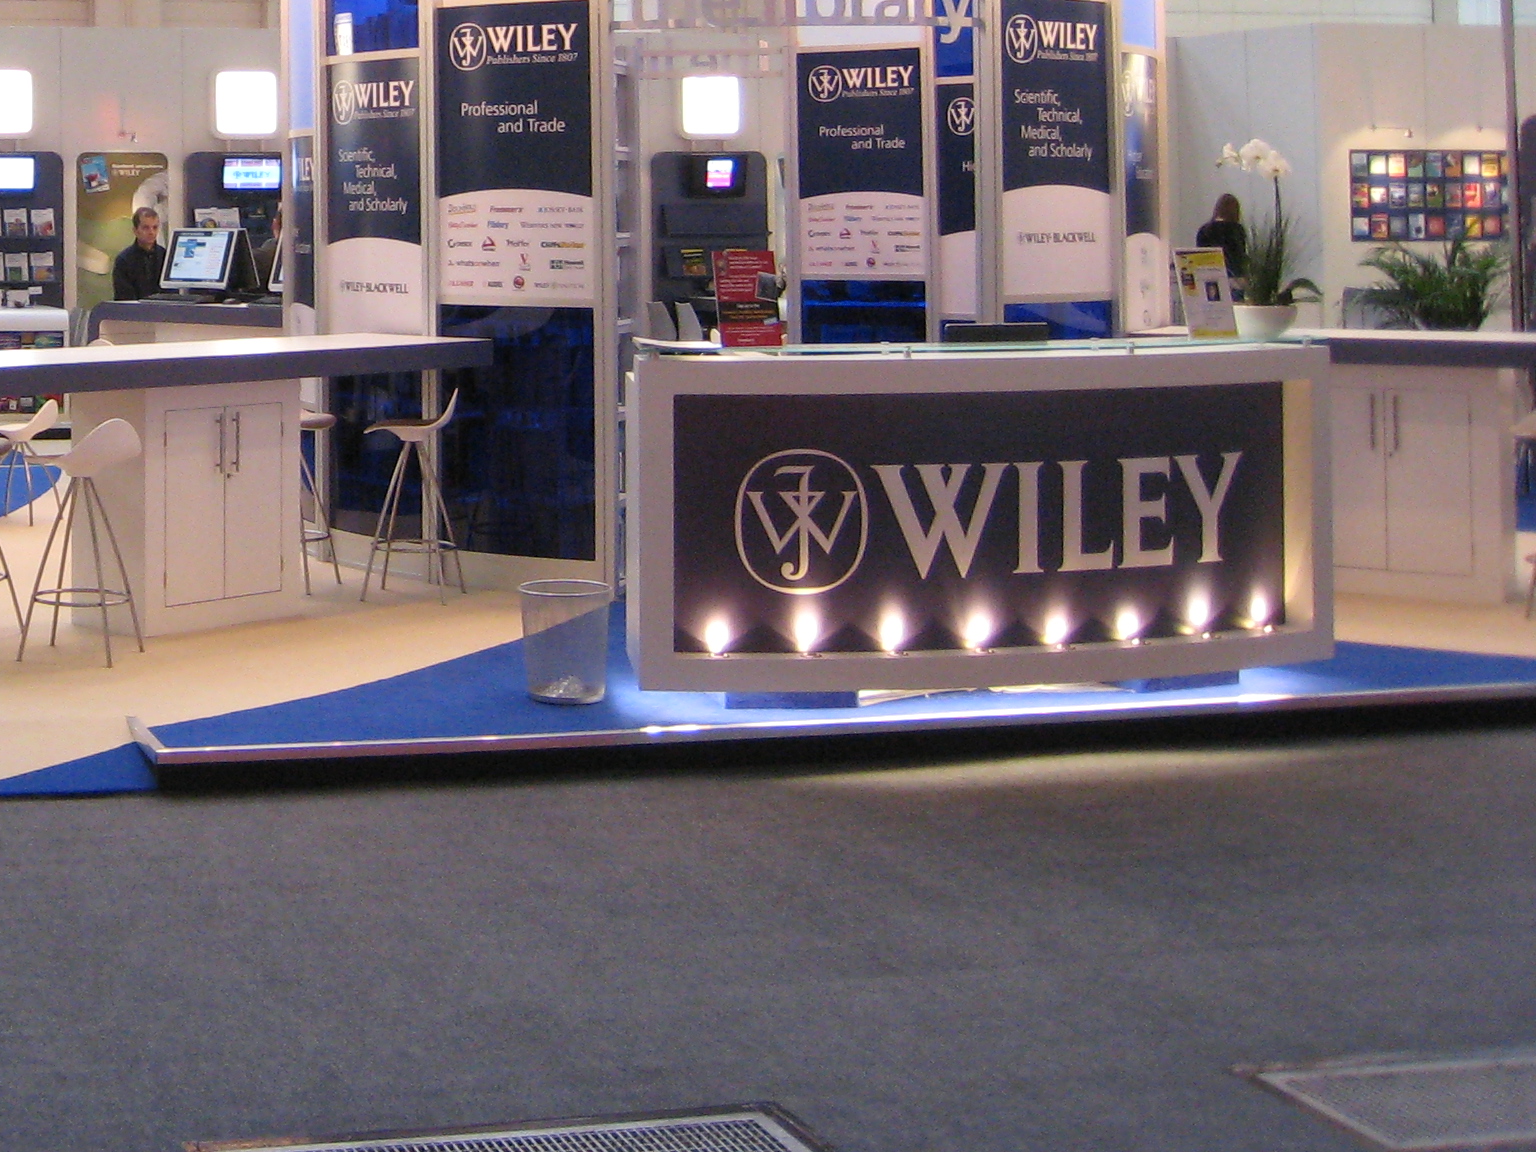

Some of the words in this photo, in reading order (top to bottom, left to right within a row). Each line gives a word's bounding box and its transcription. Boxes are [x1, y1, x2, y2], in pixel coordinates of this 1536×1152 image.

[486, 23, 579, 54] WILEY
[1037, 20, 1098, 51] WILEY
[532, 53, 557, 63] Since
[841, 65, 914, 89] WILEY
[354, 80, 415, 108] WILEY
[1014, 88, 1061, 106] Scientific,
[461, 99, 539, 117] Professional
[1037, 107, 1083, 125] Technical,
[497, 117, 523, 133] and
[526, 116, 566, 133] Trade
[819, 124, 884, 137] Professional
[1020, 125, 1063, 142] Medical,
[851, 137, 872, 150] and
[875, 137, 906, 149] Trade
[1028, 143, 1048, 158] and
[1050, 142, 1093, 162] Scholarly
[355, 163, 398, 180] Technical,
[348, 198, 364, 212] and
[365, 197, 408, 215] Scholarly
[869, 451, 1244, 579] WILEY
